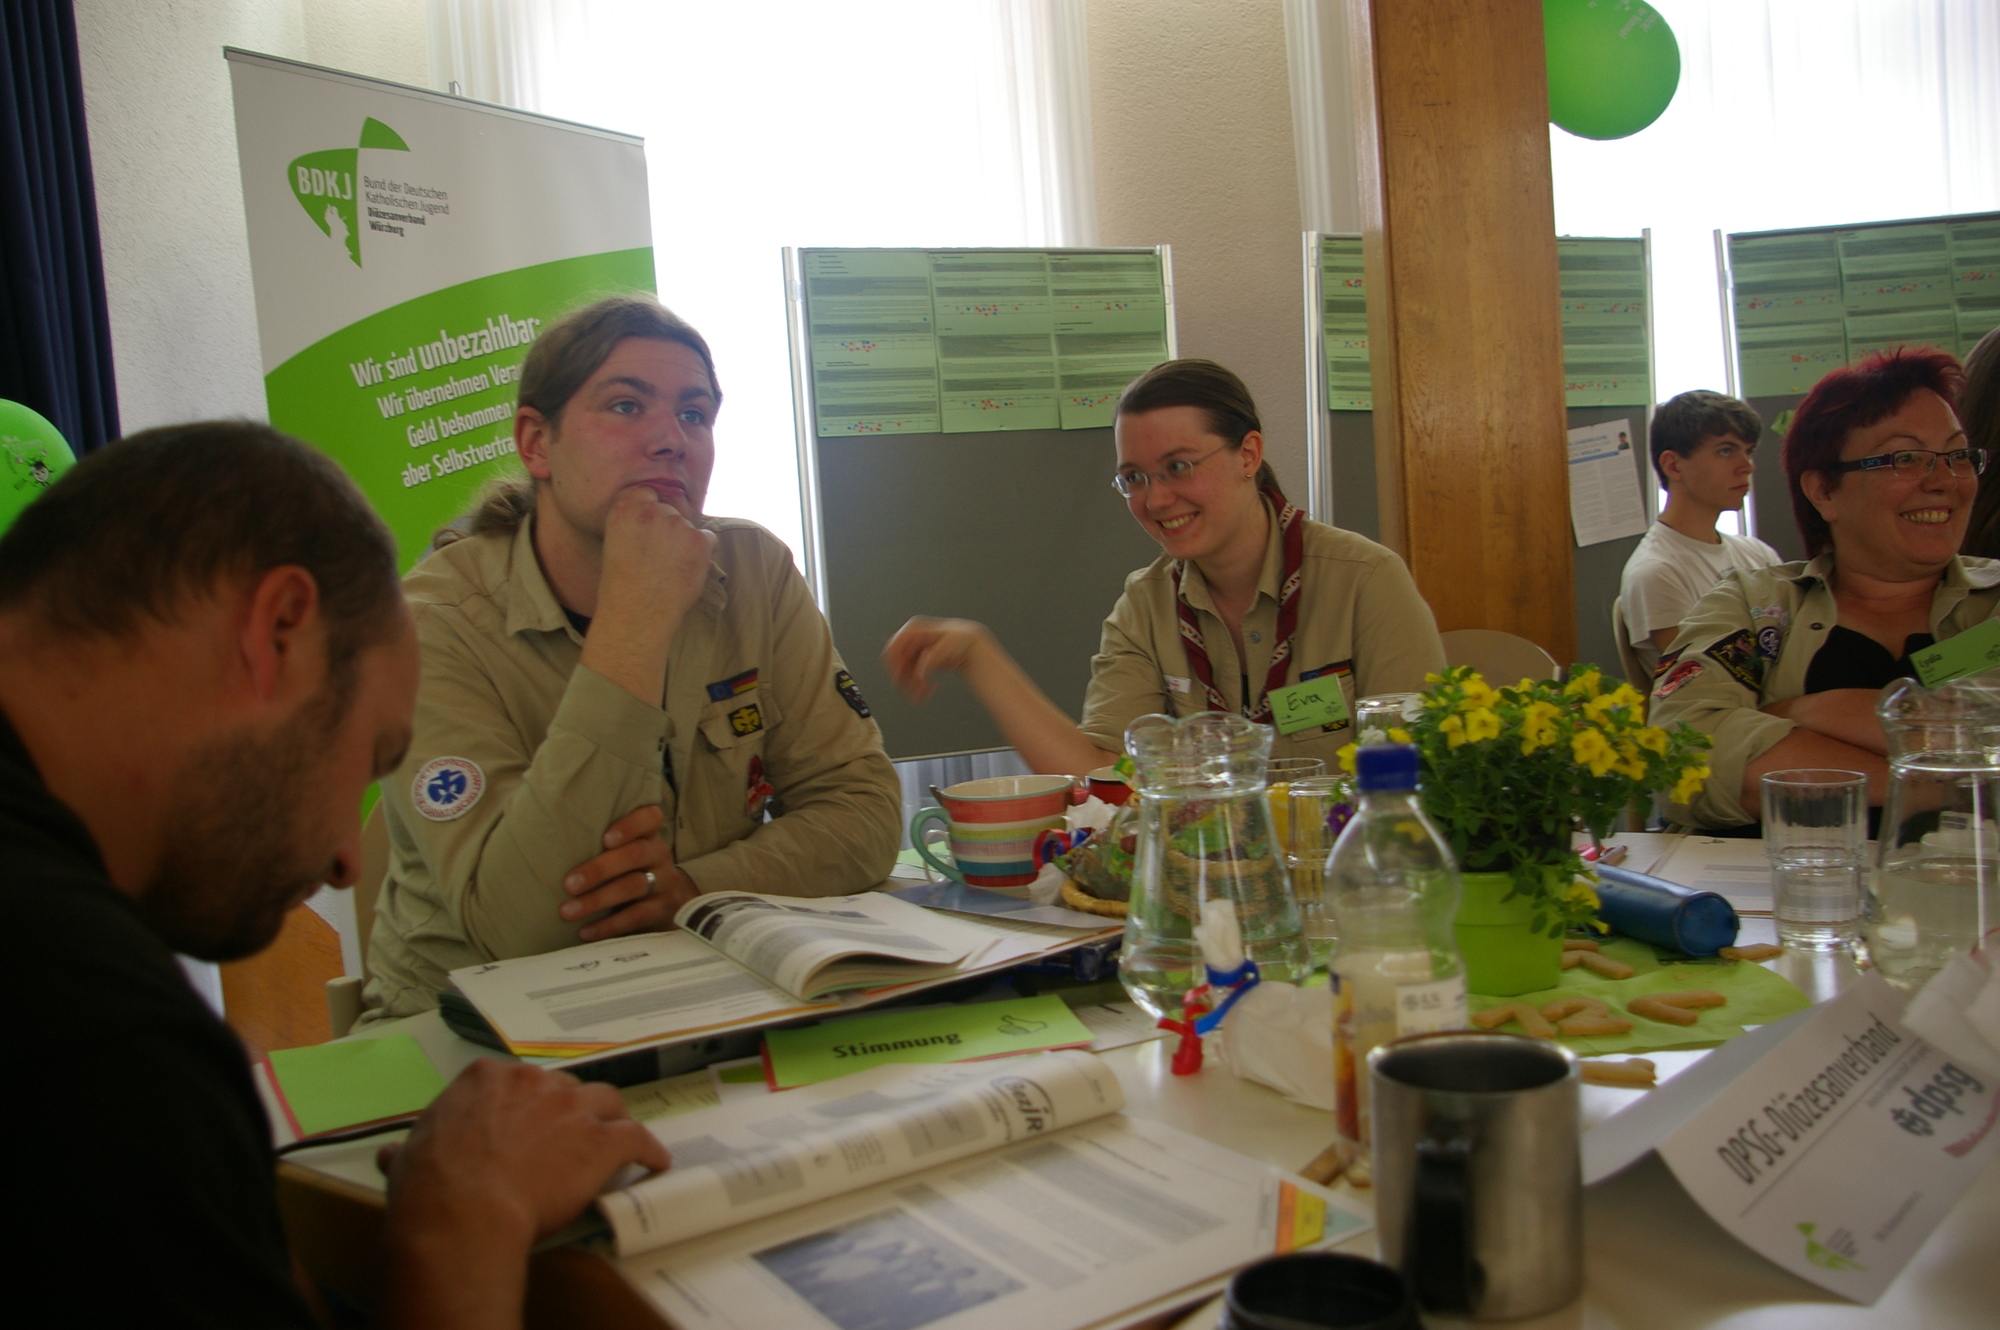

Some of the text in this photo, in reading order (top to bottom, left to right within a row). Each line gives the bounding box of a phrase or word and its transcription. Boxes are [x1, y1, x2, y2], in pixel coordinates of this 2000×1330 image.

[297, 165, 353, 200] BDKJ
[363, 176, 449, 200] Bund der Deutschen
[365, 191, 450, 216] Katholischen Jugend
[368, 219, 405, 238] Würzburg
[350, 357, 383, 388] Wir
[385, 347, 419, 380] sind
[376, 363, 523, 419] Wir übernehmen Vera
[407, 401, 513, 449] Geld bekommen
[401, 436, 517, 489] aber Selbstvertra
[1286, 692, 1324, 711] Eva
[833, 1033, 962, 1058] Stimmung
[1717, 1011, 1901, 1185] DPSG-Diözesanverband
[1901, 1062, 1986, 1120] dpsg
